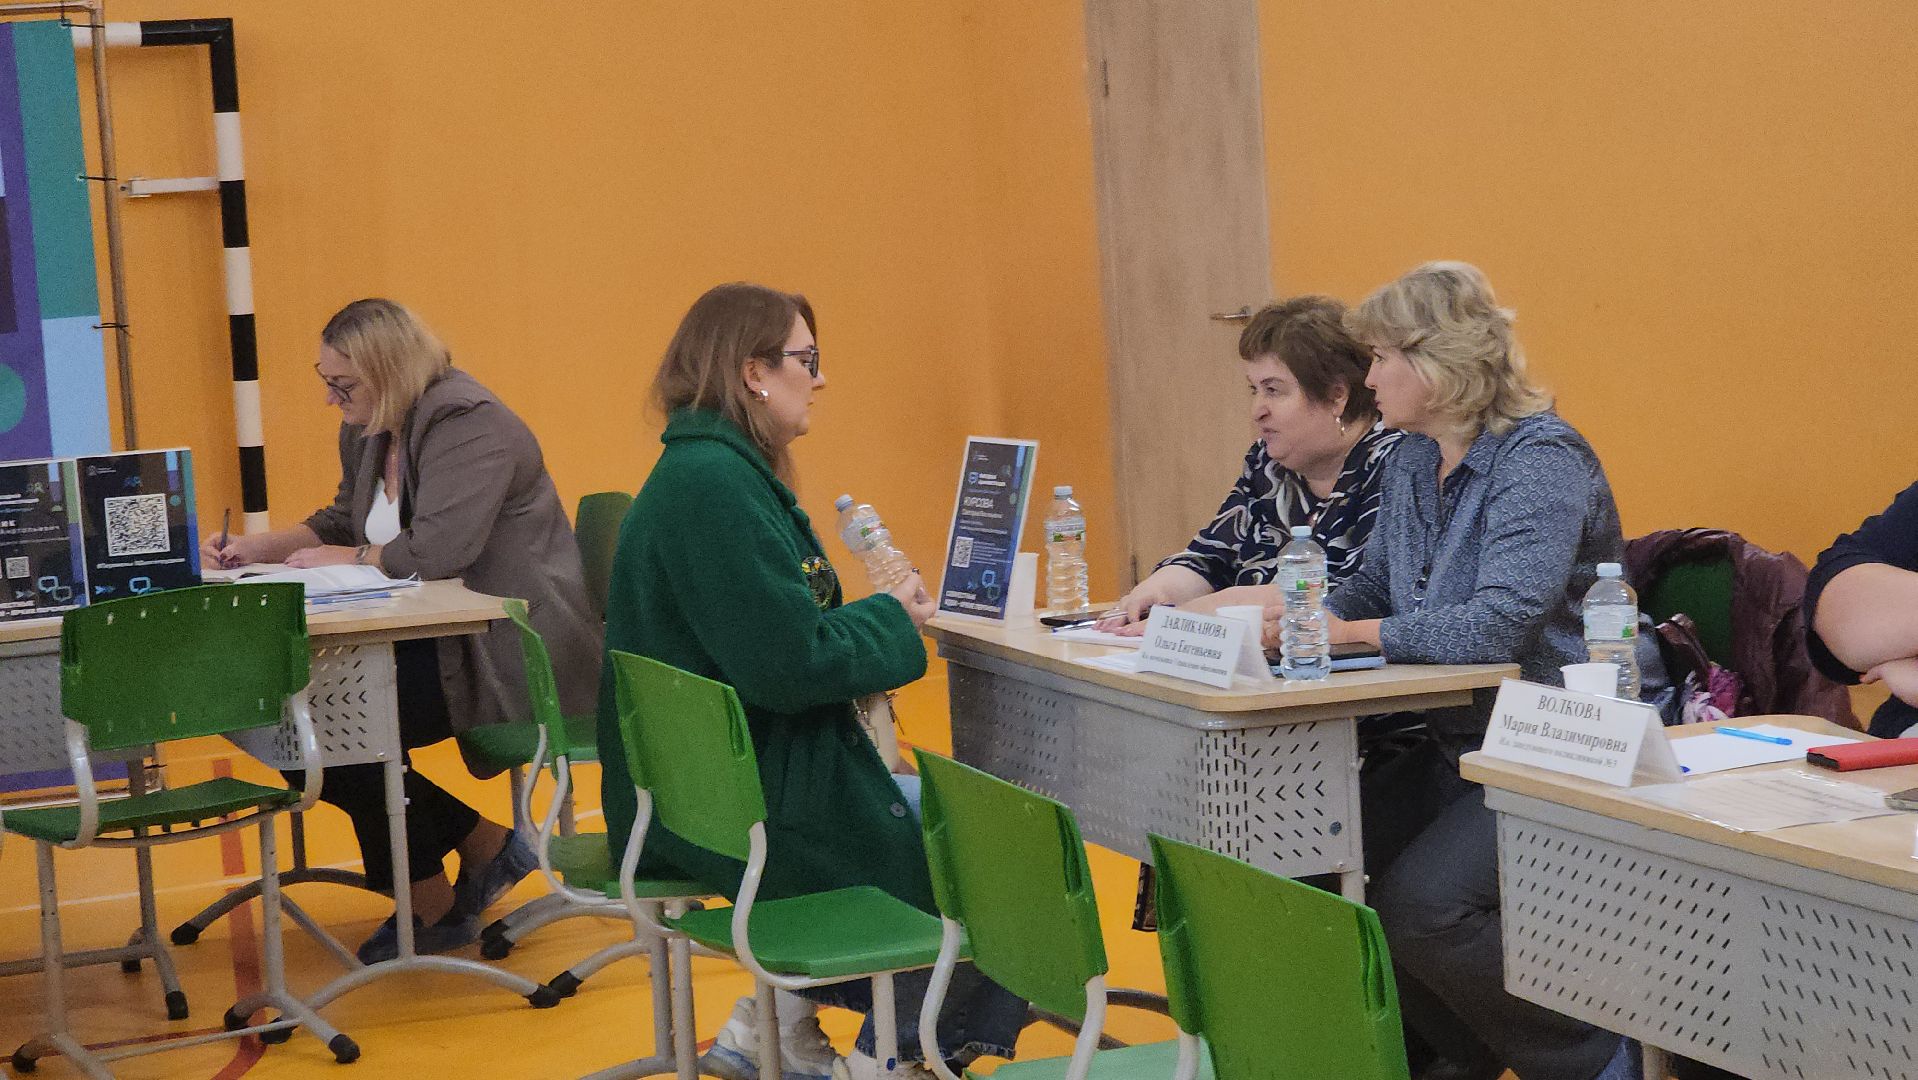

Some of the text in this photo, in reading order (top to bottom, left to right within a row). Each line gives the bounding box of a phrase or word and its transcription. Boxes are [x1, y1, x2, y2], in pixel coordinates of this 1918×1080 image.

[1537, 694, 1601, 721] ВОЛКОВА
[1500, 713, 1539, 736] Мария
[1540, 722, 1628, 753] Владимировна
